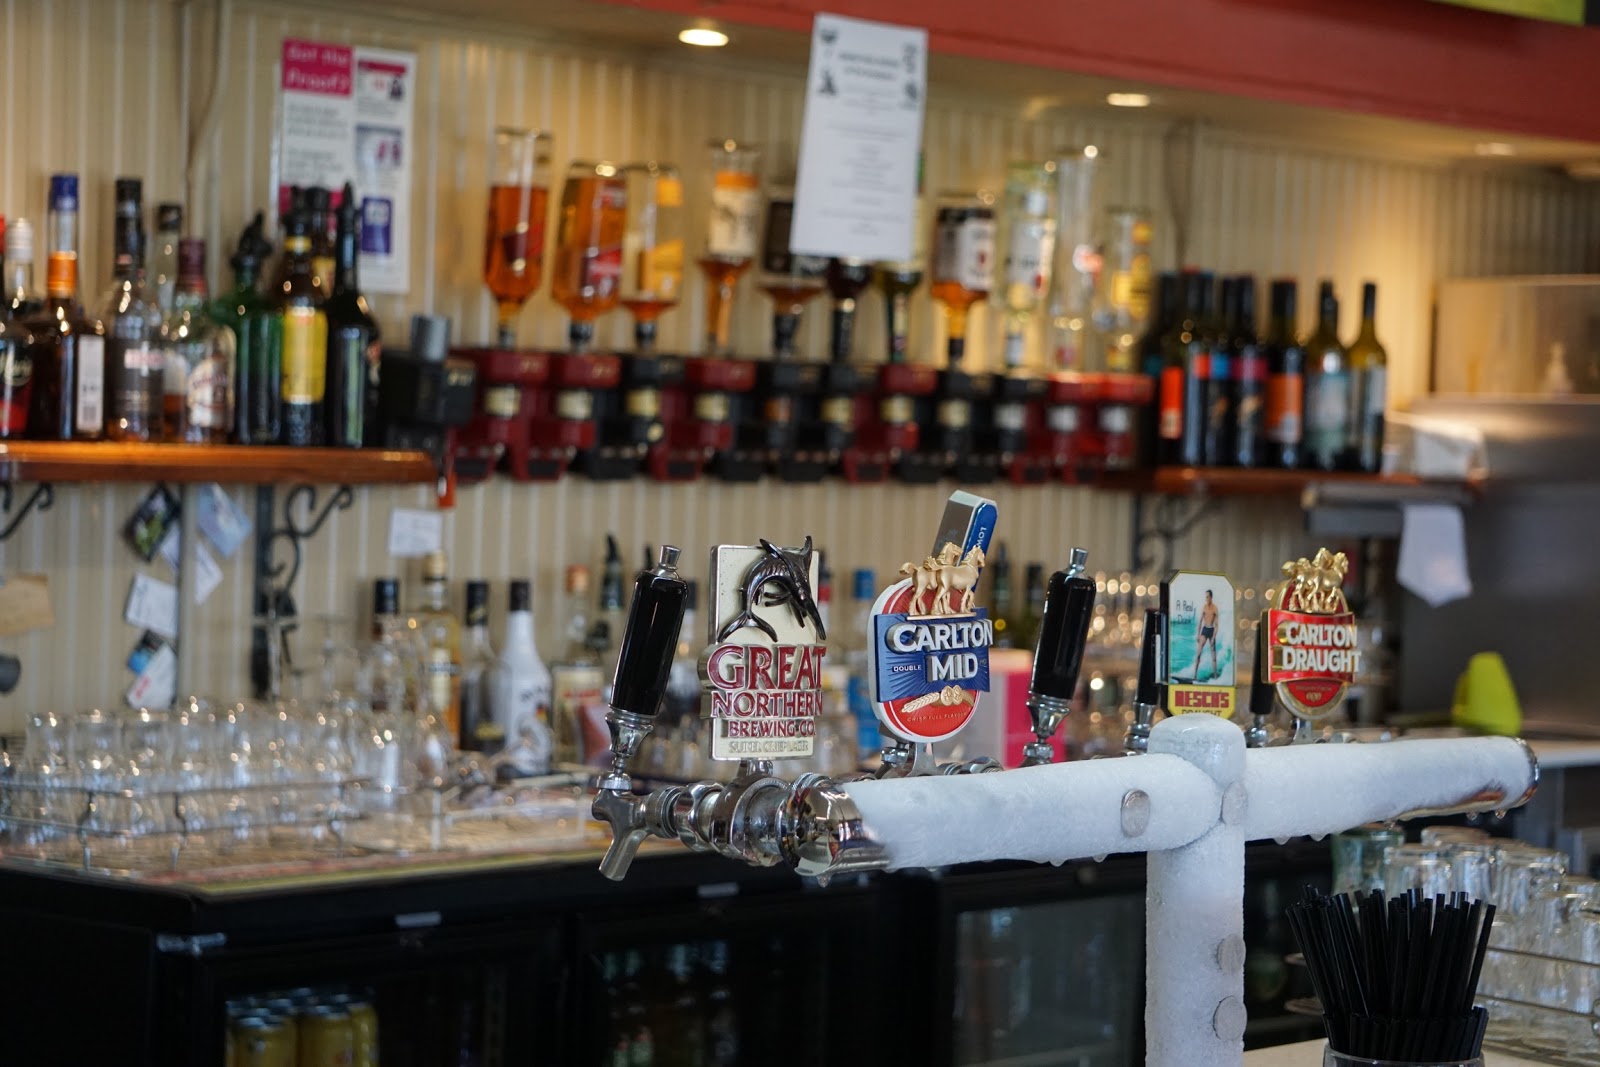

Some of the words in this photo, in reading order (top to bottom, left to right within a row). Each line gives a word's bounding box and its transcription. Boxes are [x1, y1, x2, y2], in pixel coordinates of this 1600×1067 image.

[1175, 599, 1181, 611] A
[1183, 600, 1194, 612] Real
[891, 619, 994, 652] CARLTON
[1285, 622, 1358, 647] CARLTON
[706, 644, 827, 690] GREAT
[893, 664, 922, 673] DOUBLE
[930, 652, 979, 681] MID
[1281, 647, 1362, 673] DRAUGHT
[710, 690, 824, 718] NORTHERN
[728, 719, 796, 738] BREWING
